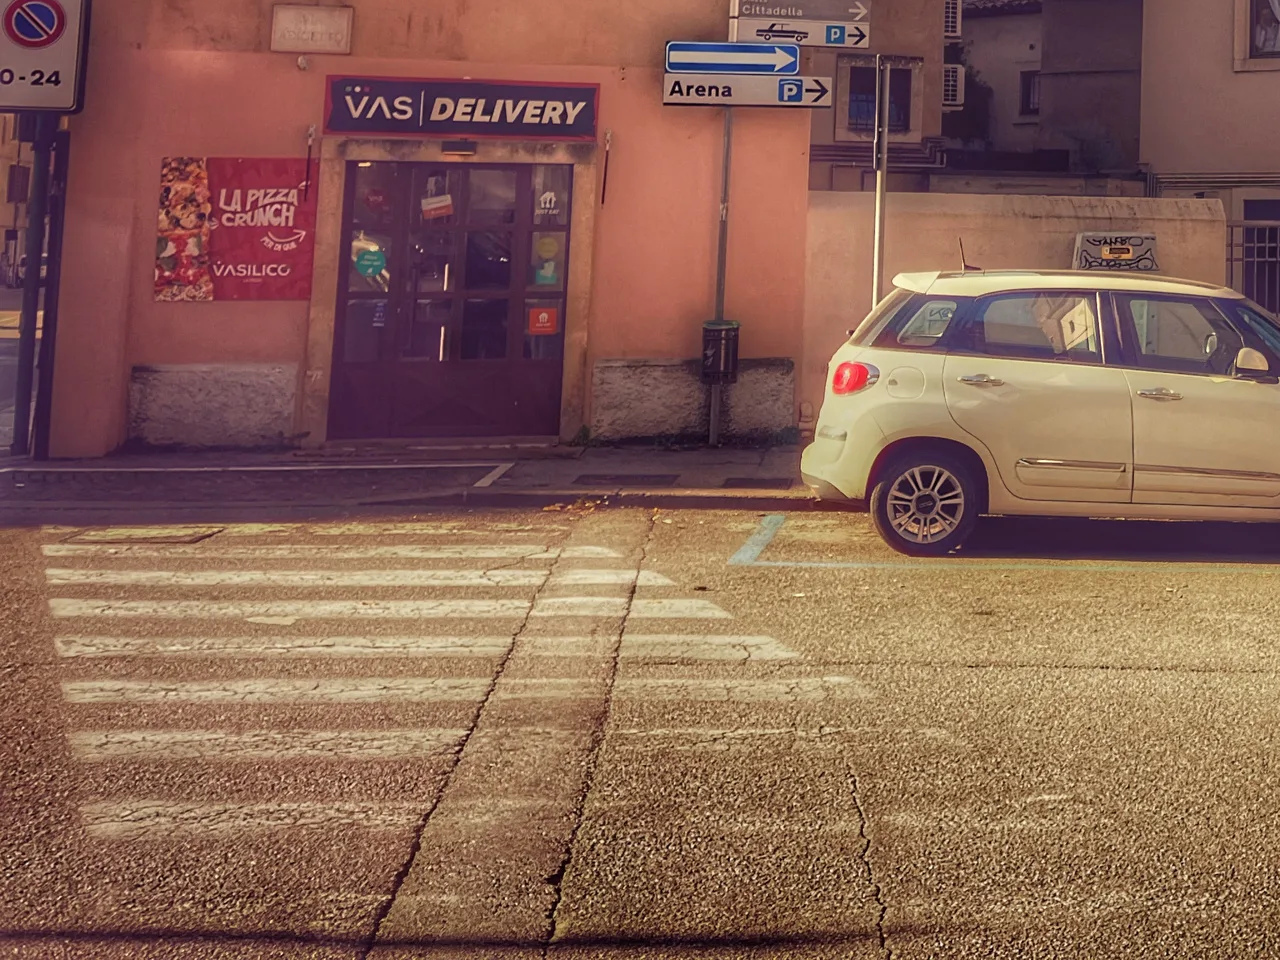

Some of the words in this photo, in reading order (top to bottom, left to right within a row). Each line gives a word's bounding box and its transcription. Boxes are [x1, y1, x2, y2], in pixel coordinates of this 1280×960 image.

[742, 4, 803, 17] Cittadella
[669, 80, 733, 97] Arena
[344, 94, 414, 120] VAS
[429, 96, 587, 125] DELIVERY
[219, 189, 241, 212] LA
[245, 189, 298, 211] PIZZA
[221, 203, 295, 226] CRUNCH
[212, 262, 291, 277] VASILICO
